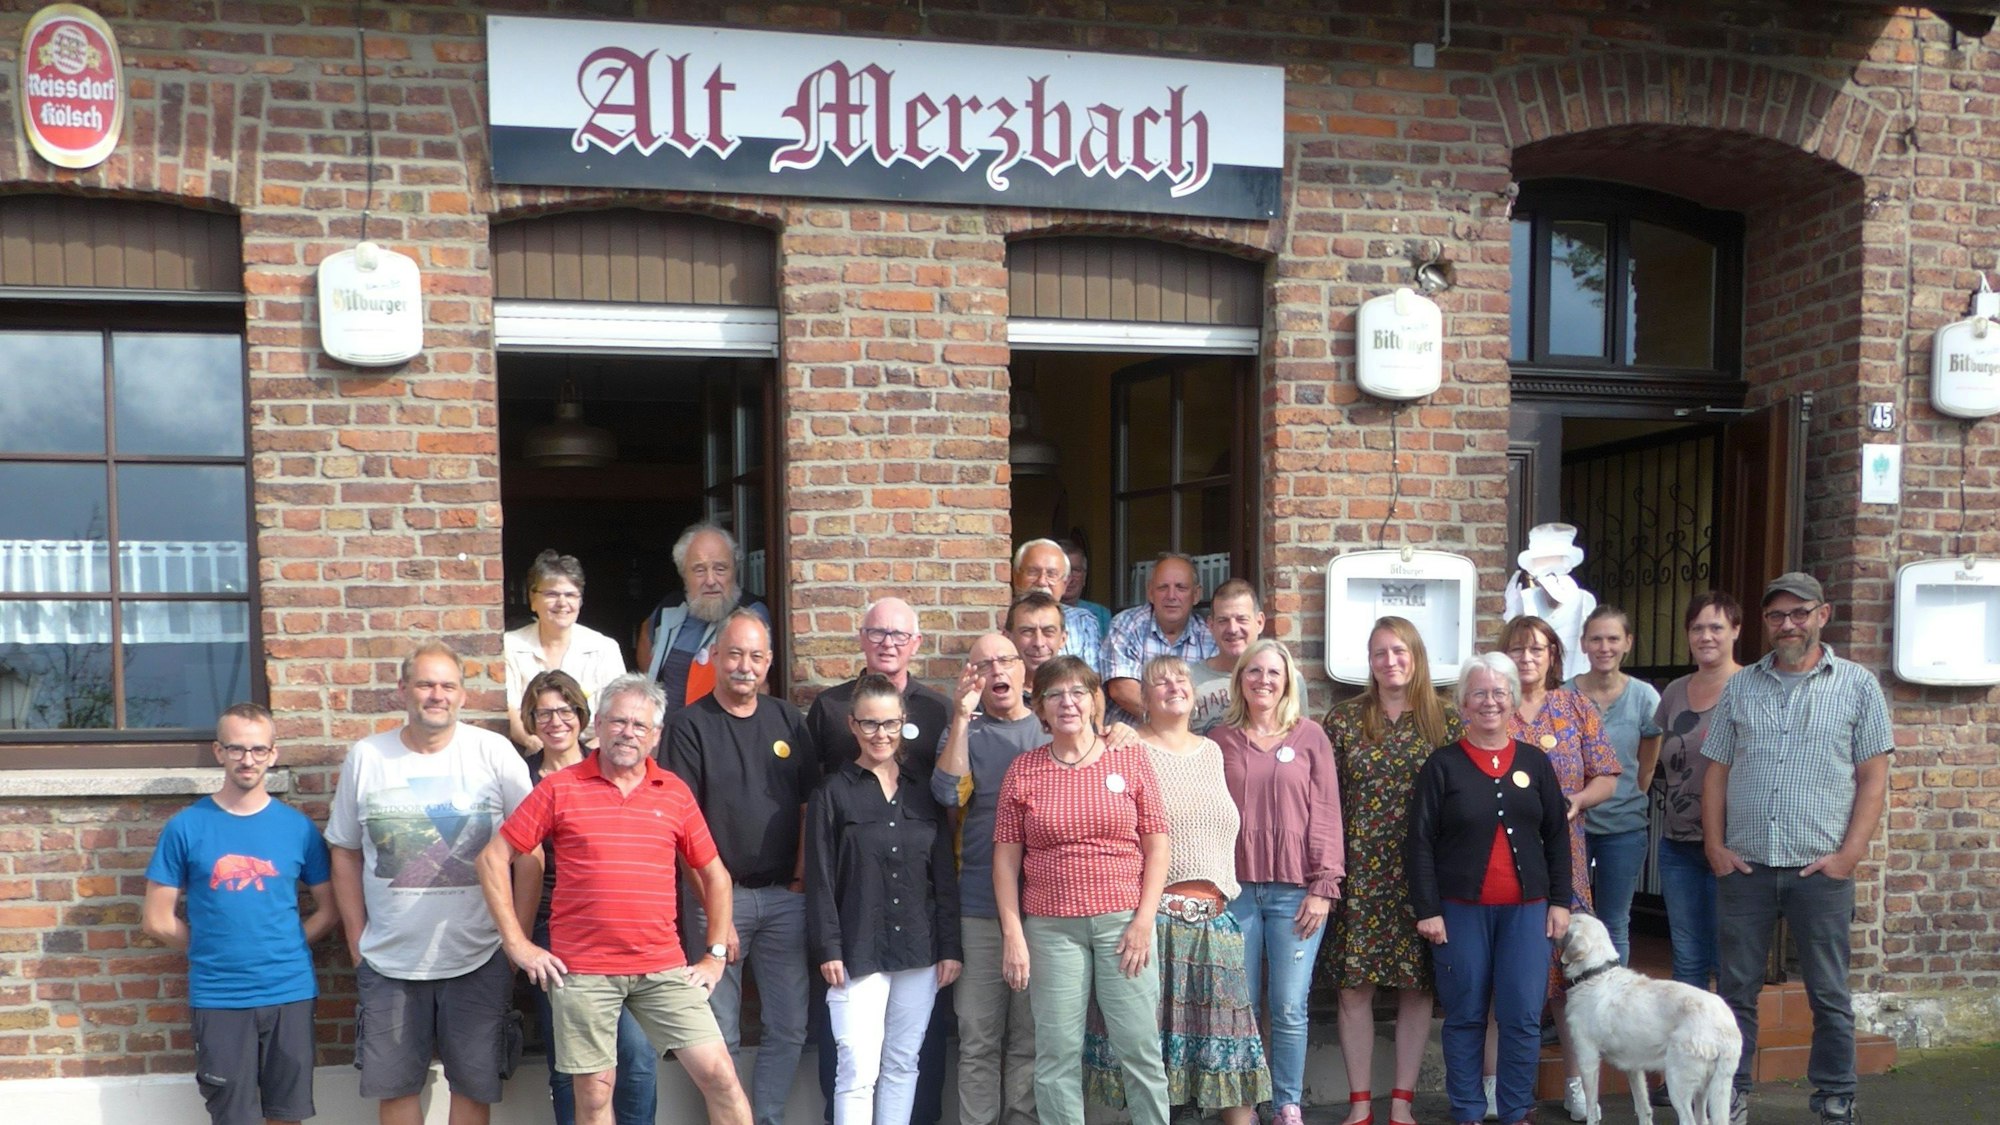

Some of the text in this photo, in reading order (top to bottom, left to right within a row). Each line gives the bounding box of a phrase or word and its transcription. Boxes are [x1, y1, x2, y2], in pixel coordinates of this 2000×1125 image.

[27, 73, 116, 100] Reissdorf
[40, 102, 103, 132] Kölsch
[572, 46, 1213, 197] Alt Merzbach
[1948, 353, 2000, 376] Bitburge
[1873, 404, 1893, 428] 45
